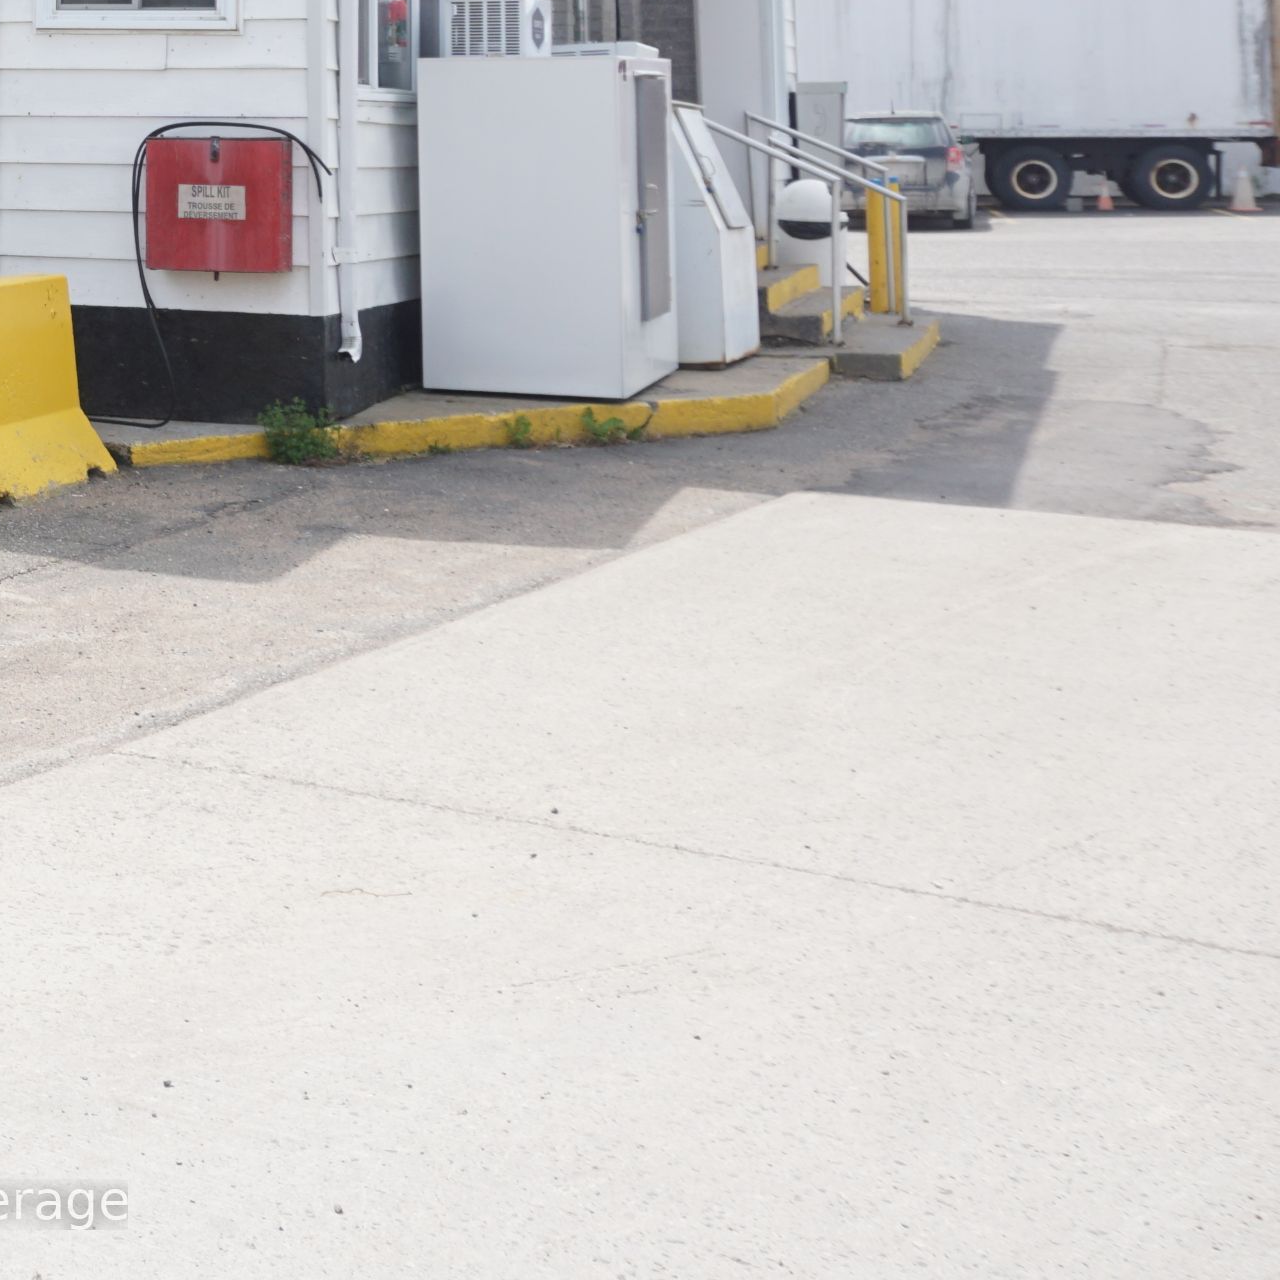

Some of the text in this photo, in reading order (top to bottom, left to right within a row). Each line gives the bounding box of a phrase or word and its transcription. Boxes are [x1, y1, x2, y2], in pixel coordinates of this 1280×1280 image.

[191, 185, 231, 198] SPILL KIT
[187, 202, 235, 210] TROUSSE DE
